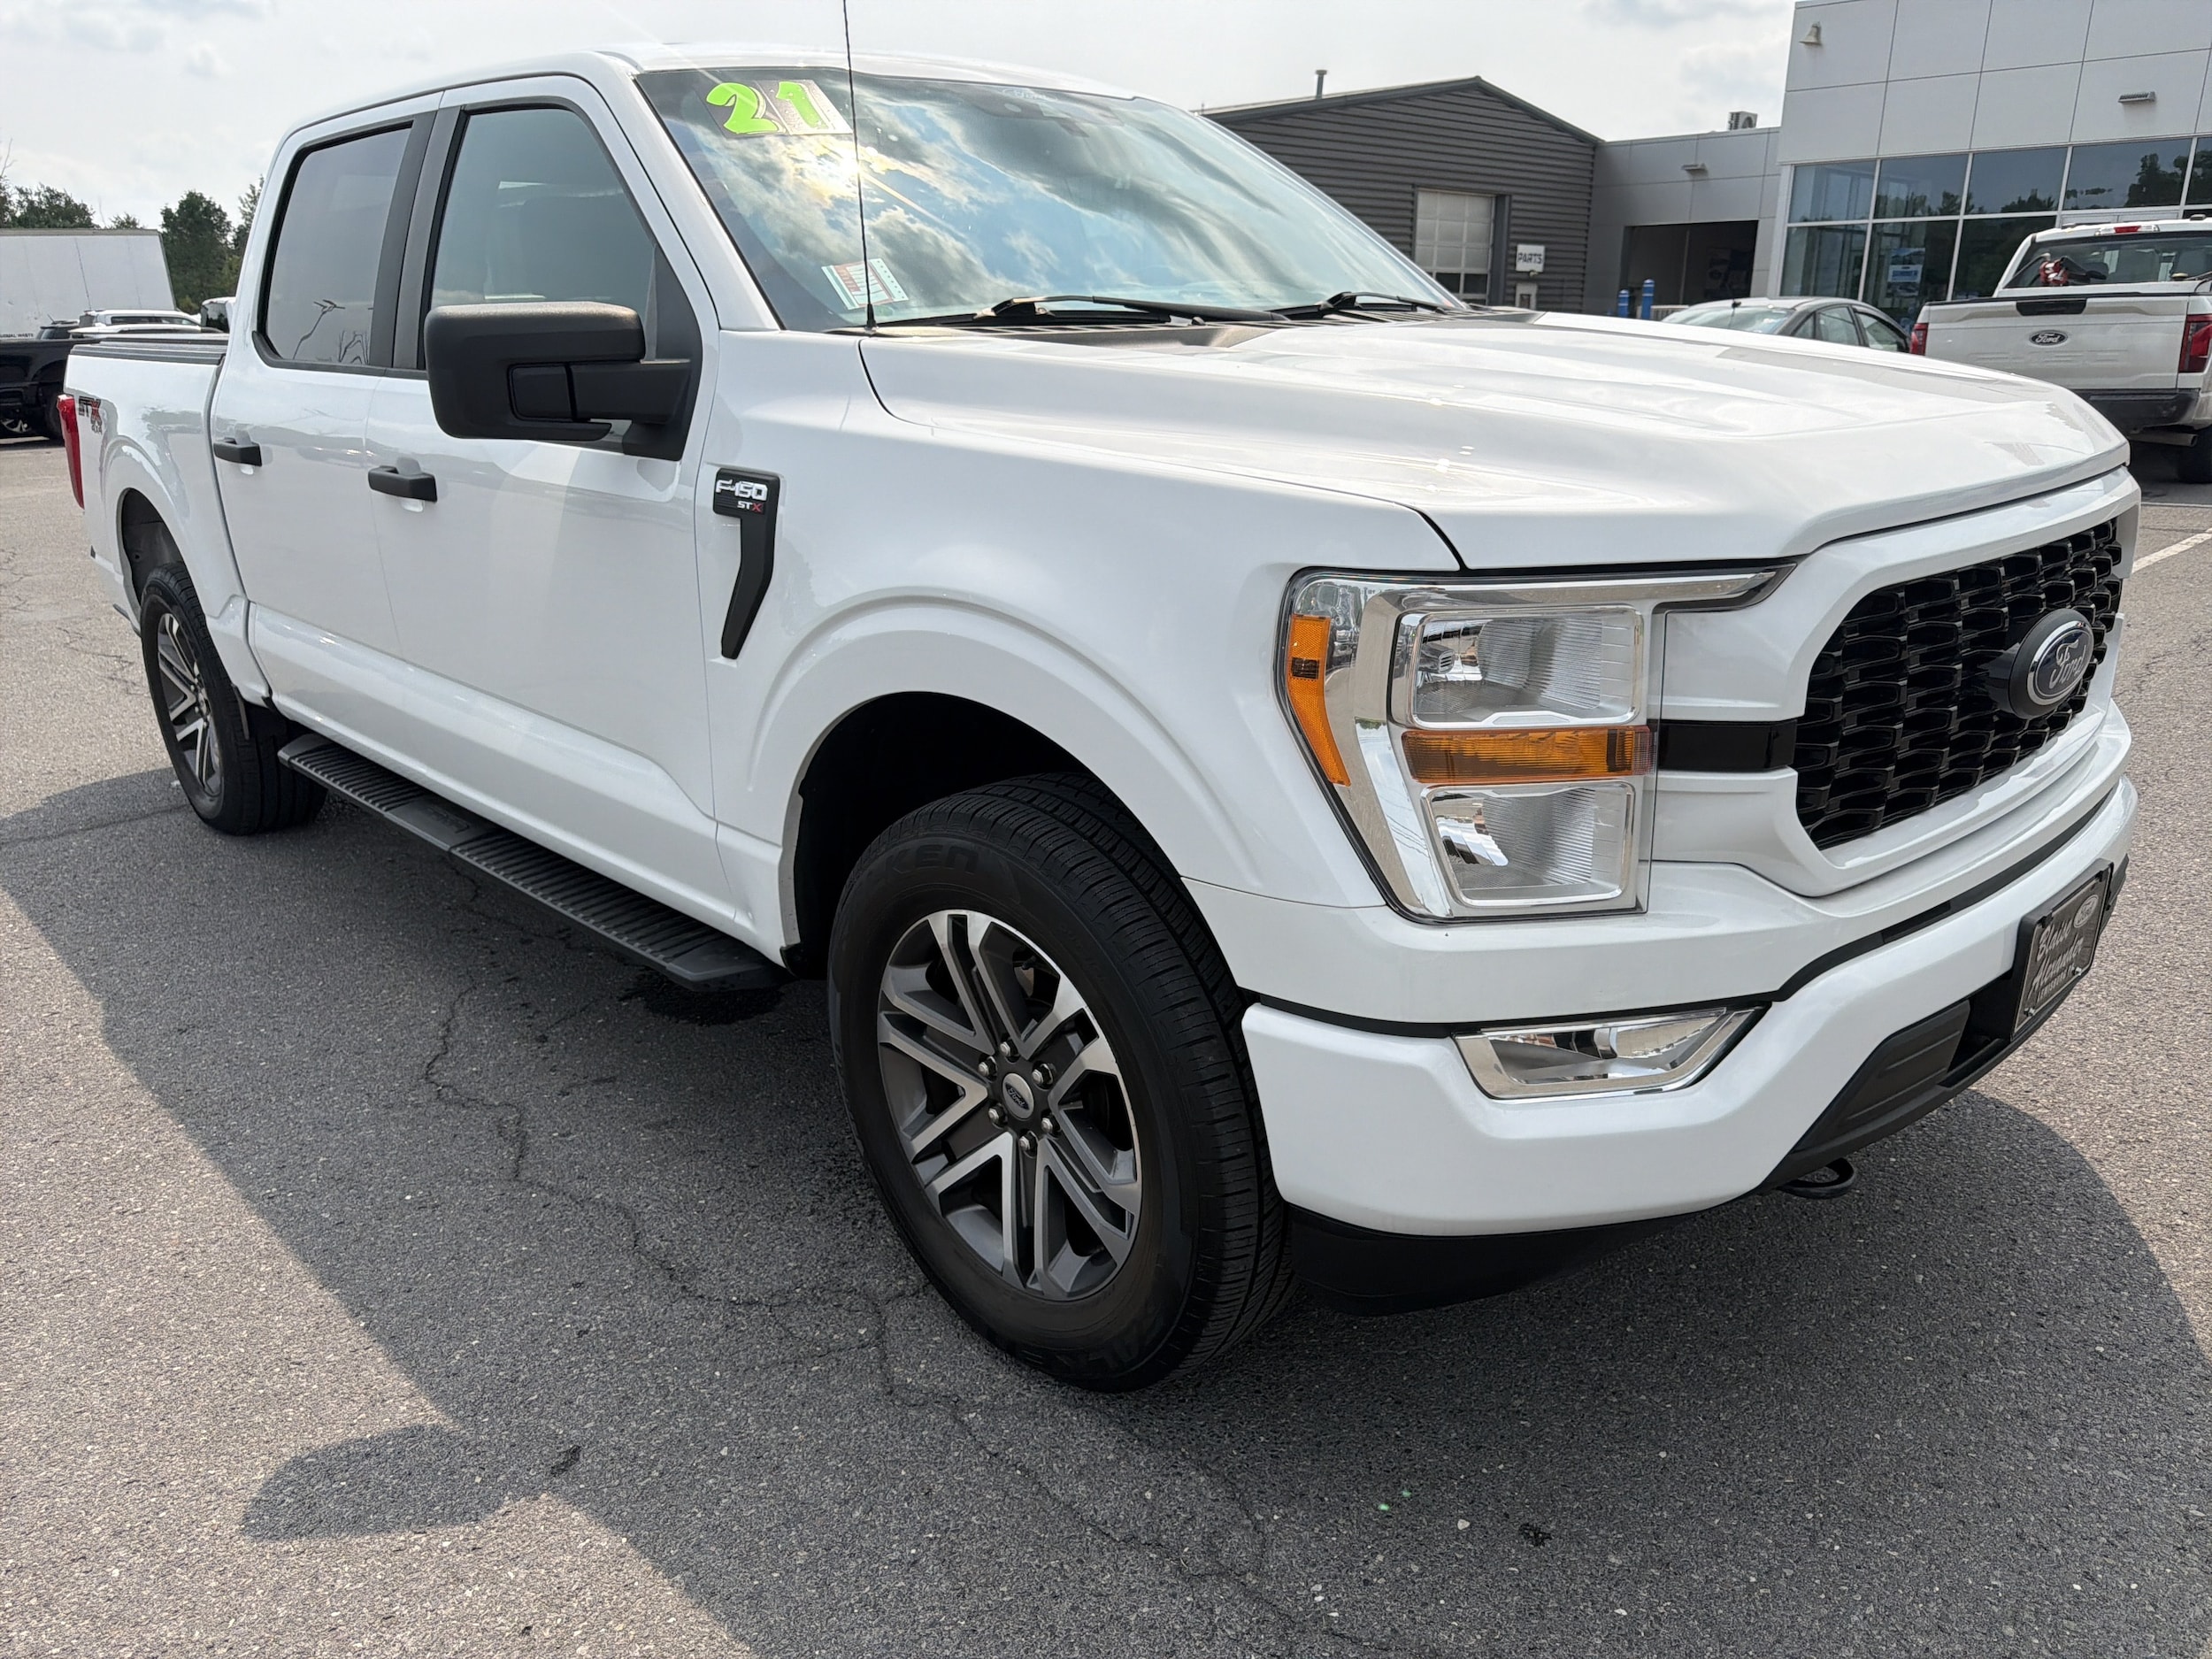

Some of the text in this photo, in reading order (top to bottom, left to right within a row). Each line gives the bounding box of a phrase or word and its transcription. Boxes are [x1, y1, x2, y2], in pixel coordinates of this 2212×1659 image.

[706, 81, 834, 134] 21
[1517, 252, 1543, 264] PARTS
[2034, 332, 2062, 343] Ford
[78, 396, 103, 426] STX
[715, 479, 768, 502] F-150
[736, 500, 764, 512] STX
[2048, 638, 2087, 689] Ford
[2037, 920, 2073, 961] Blaise
[2027, 933, 2084, 1000] Alexander
[1007, 1087, 1026, 1106] Ford
